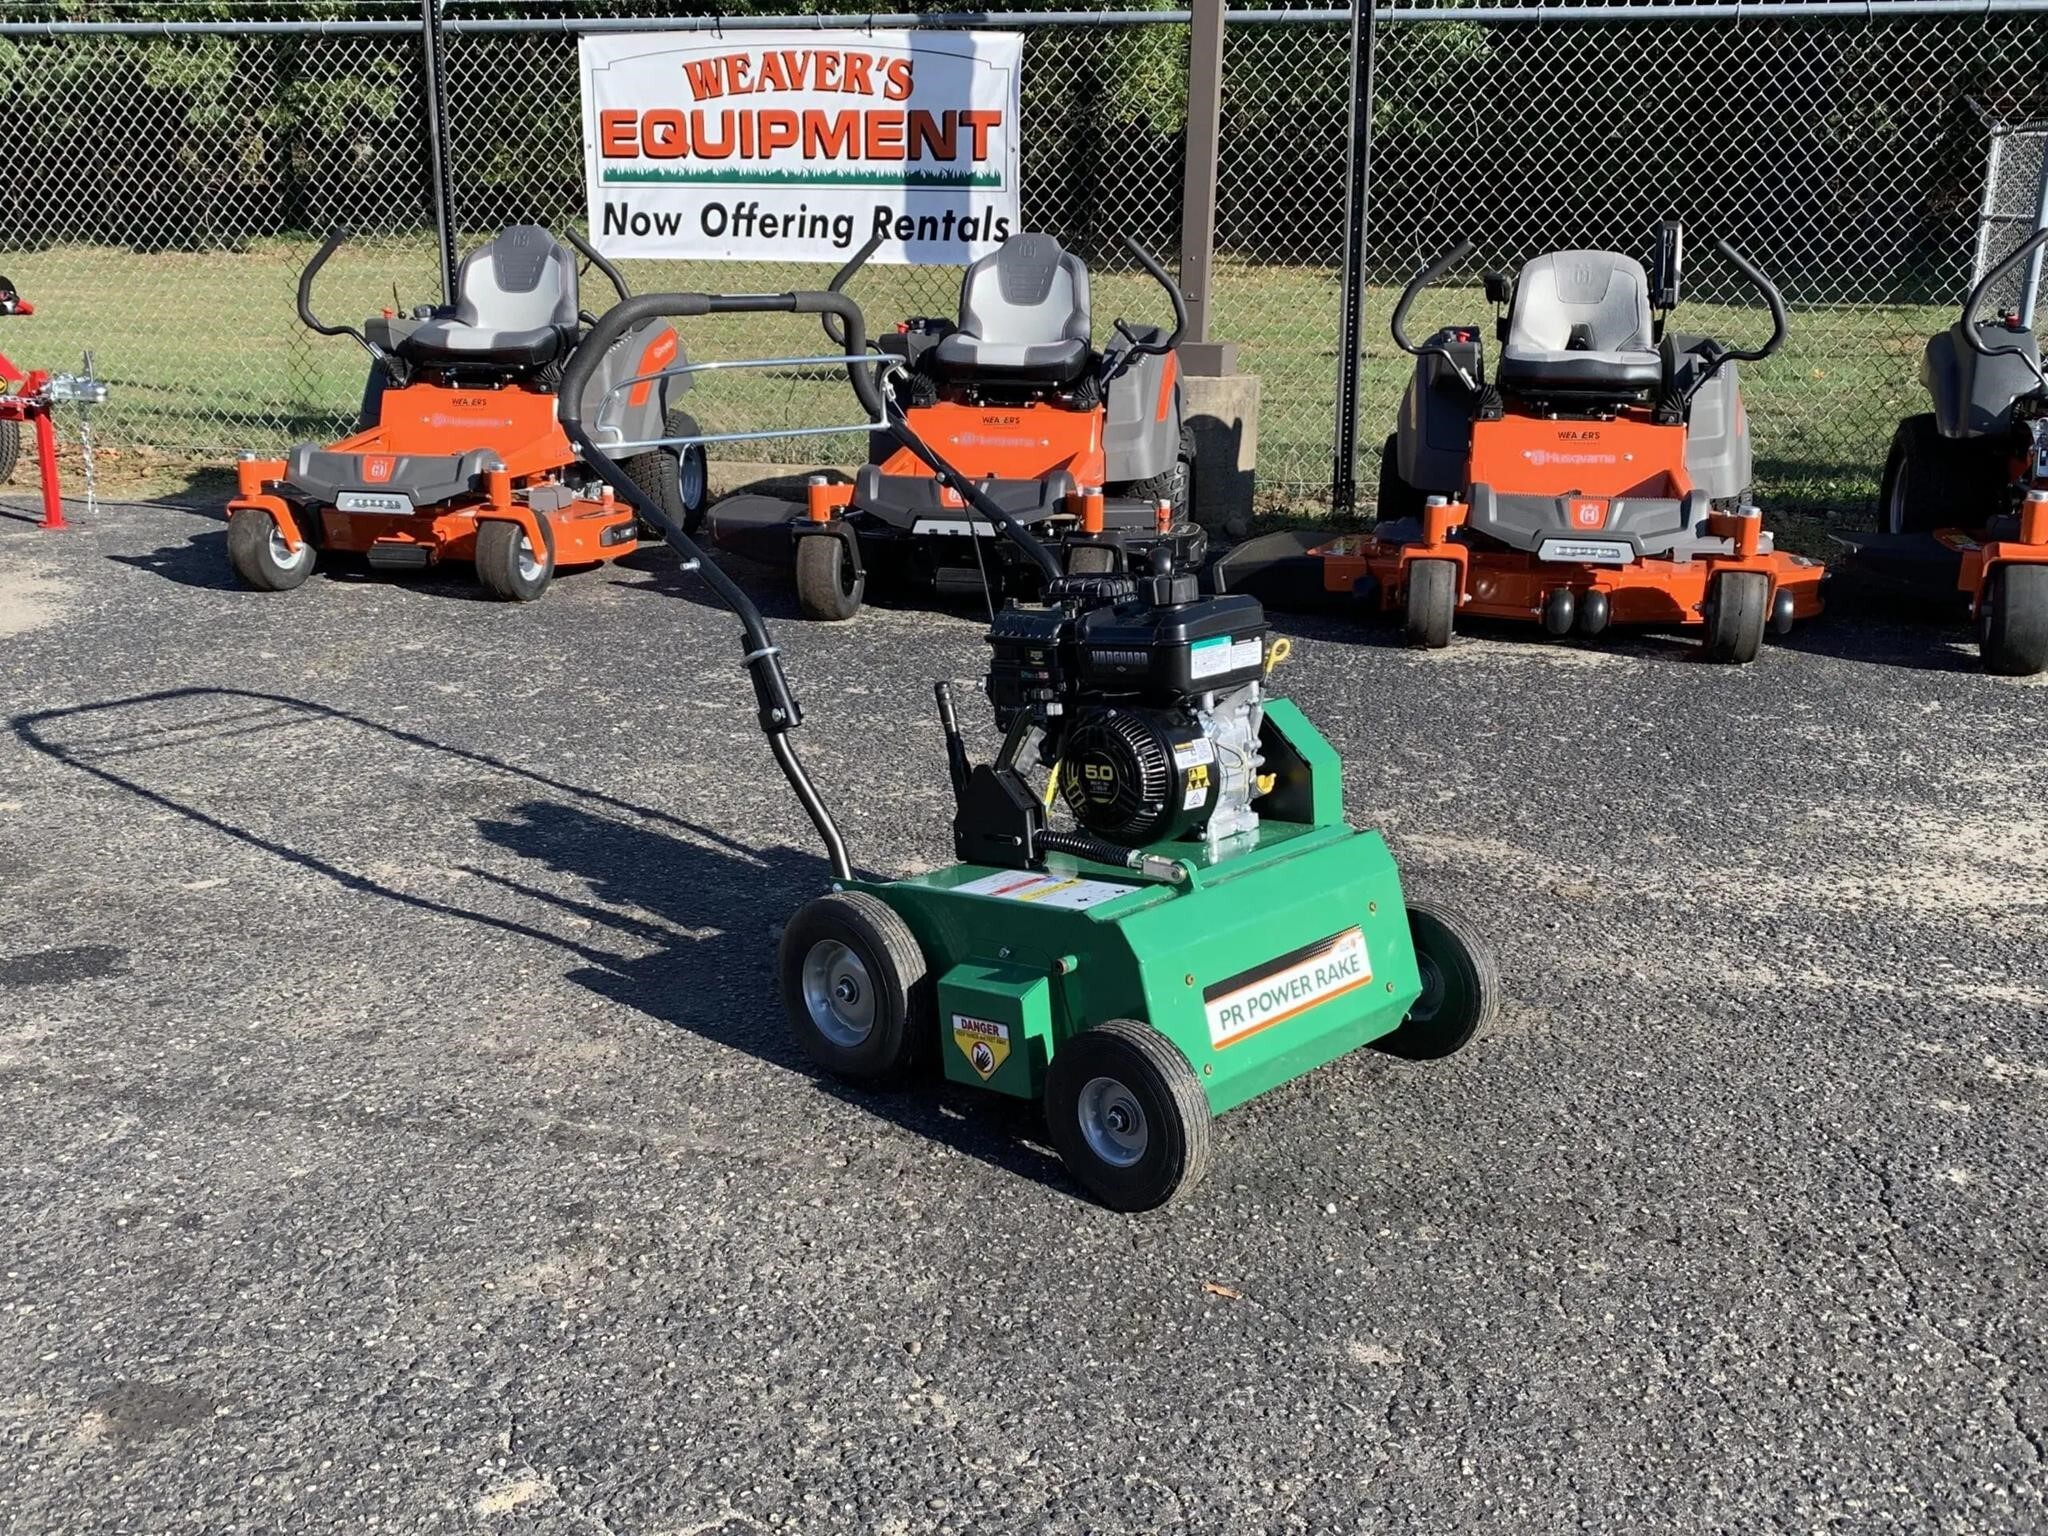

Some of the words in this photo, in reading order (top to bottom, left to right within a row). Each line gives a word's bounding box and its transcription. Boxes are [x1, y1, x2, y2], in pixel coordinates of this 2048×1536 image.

[682, 49, 915, 101] WEAVER'S
[600, 108, 1003, 161] EQUIPMENT
[602, 201, 683, 236] Now
[700, 201, 855, 248] Offering
[870, 203, 1010, 243] Rentals
[1558, 431, 1600, 439] WEAERS
[1219, 1005, 1244, 1030] PR
[1247, 975, 1312, 1018] POWER
[1315, 954, 1360, 988] RAKE
[961, 1018, 1000, 1036] DANGER
